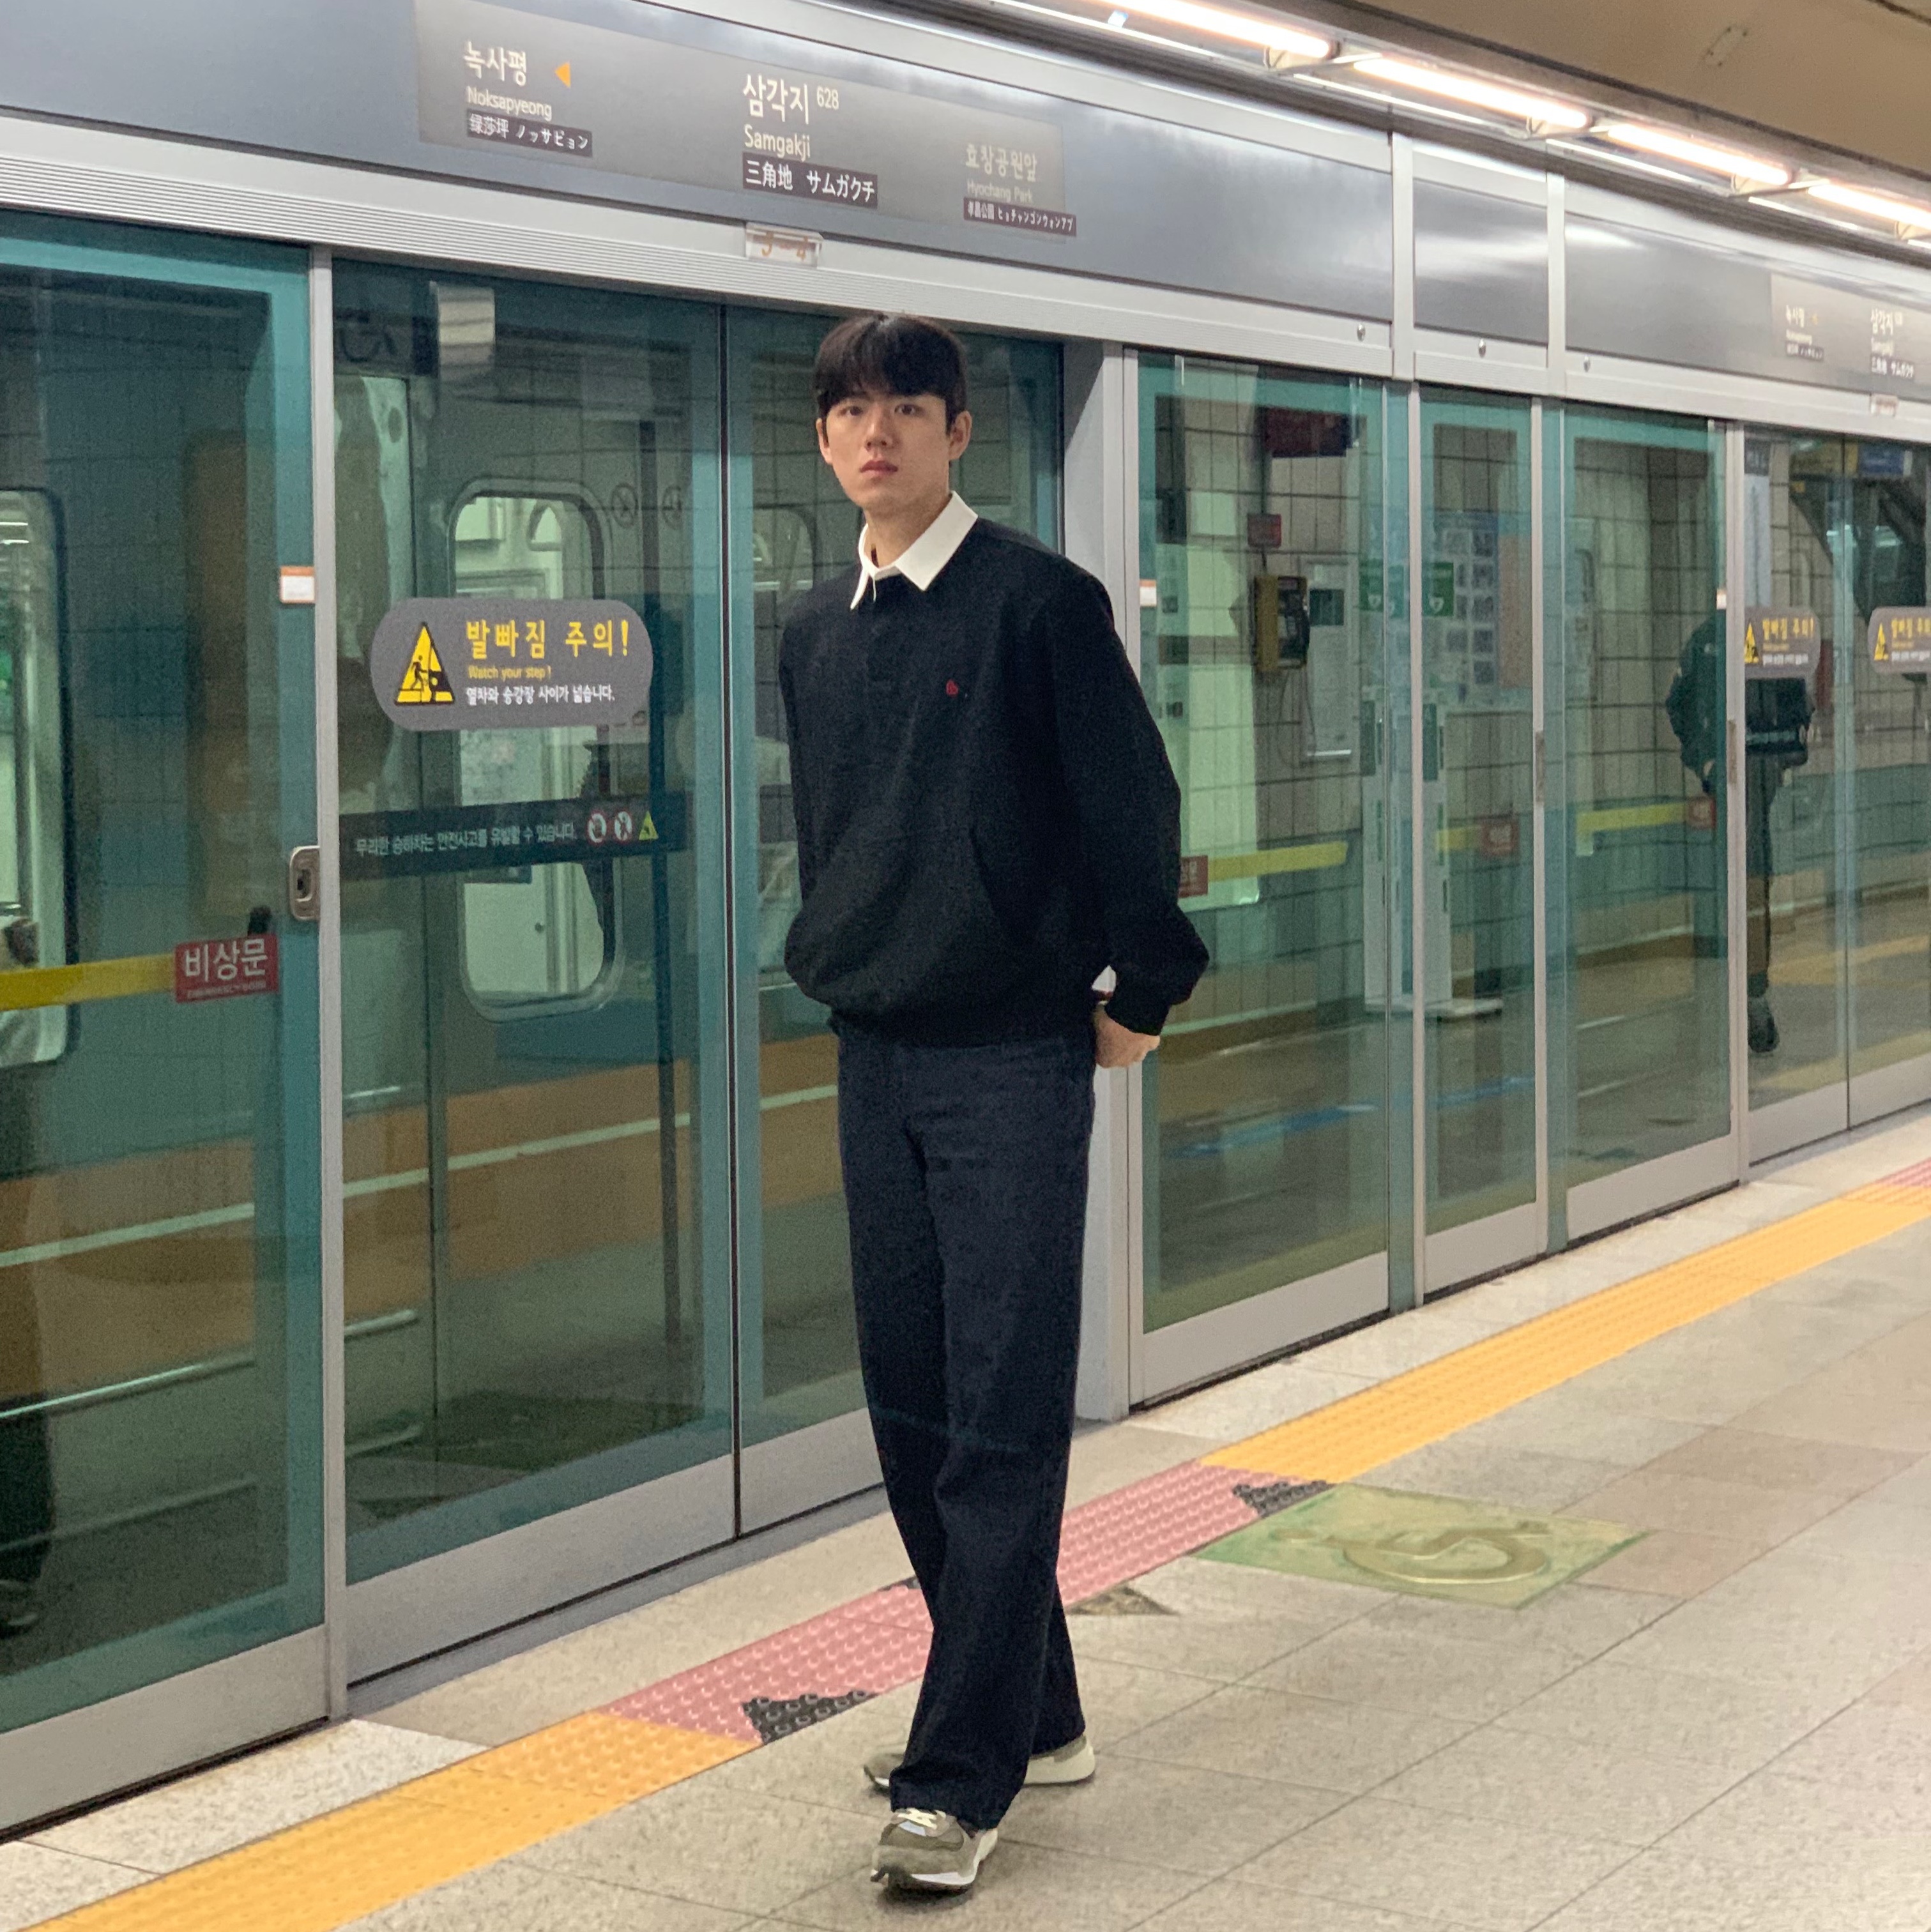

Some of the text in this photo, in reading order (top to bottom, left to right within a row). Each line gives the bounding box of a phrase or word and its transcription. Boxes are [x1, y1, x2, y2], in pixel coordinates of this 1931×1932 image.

[463, 41, 527, 86] 녹사평
[466, 86, 553, 121] Noksapyeong
[742, 73, 839, 125] 삼각지 628
[744, 124, 811, 162] Samgakji
[745, 160, 875, 202] 三角地 サムガクチ
[966, 144, 1037, 182] 효창공원앞
[966, 179, 1011, 203] Hyochang
[466, 619, 629, 660] 발빠짐 주의!
[468, 666, 498, 679] Watch
[501, 667, 523, 682] your
[465, 686, 500, 706] 열차와
[503, 686, 535, 705] 승강장
[538, 685, 569, 703] 사이가
[523, 826, 534, 844] 수
[185, 938, 268, 982] 비상문
